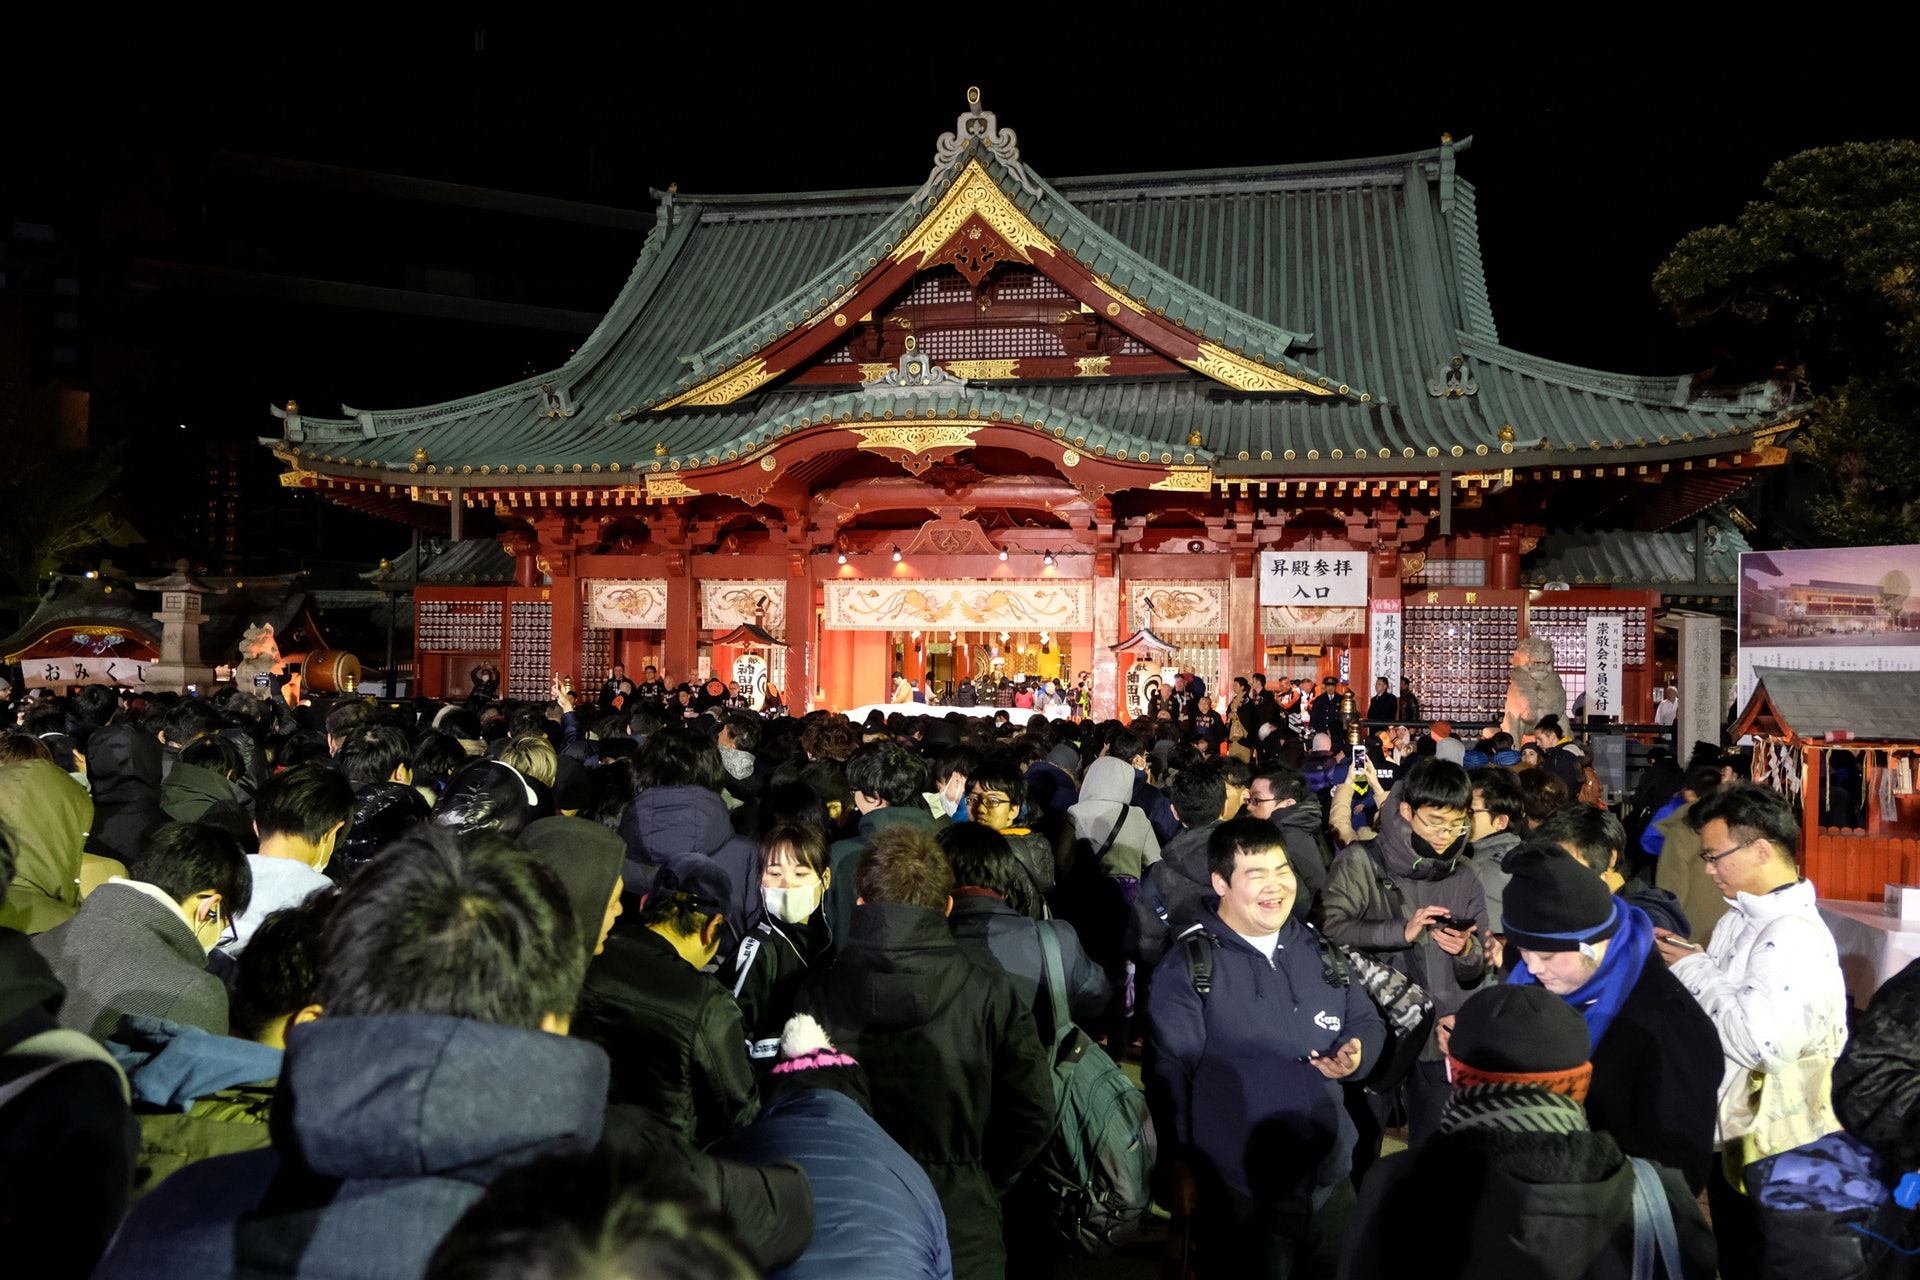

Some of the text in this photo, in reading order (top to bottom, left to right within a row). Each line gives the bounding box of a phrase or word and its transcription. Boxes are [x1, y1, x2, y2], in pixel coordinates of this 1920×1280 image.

[1271, 559, 1353, 577] 昇殿参拝
[1292, 585, 1331, 599] 入口
[1595, 622, 1610, 711] 崇敬会々員受付
